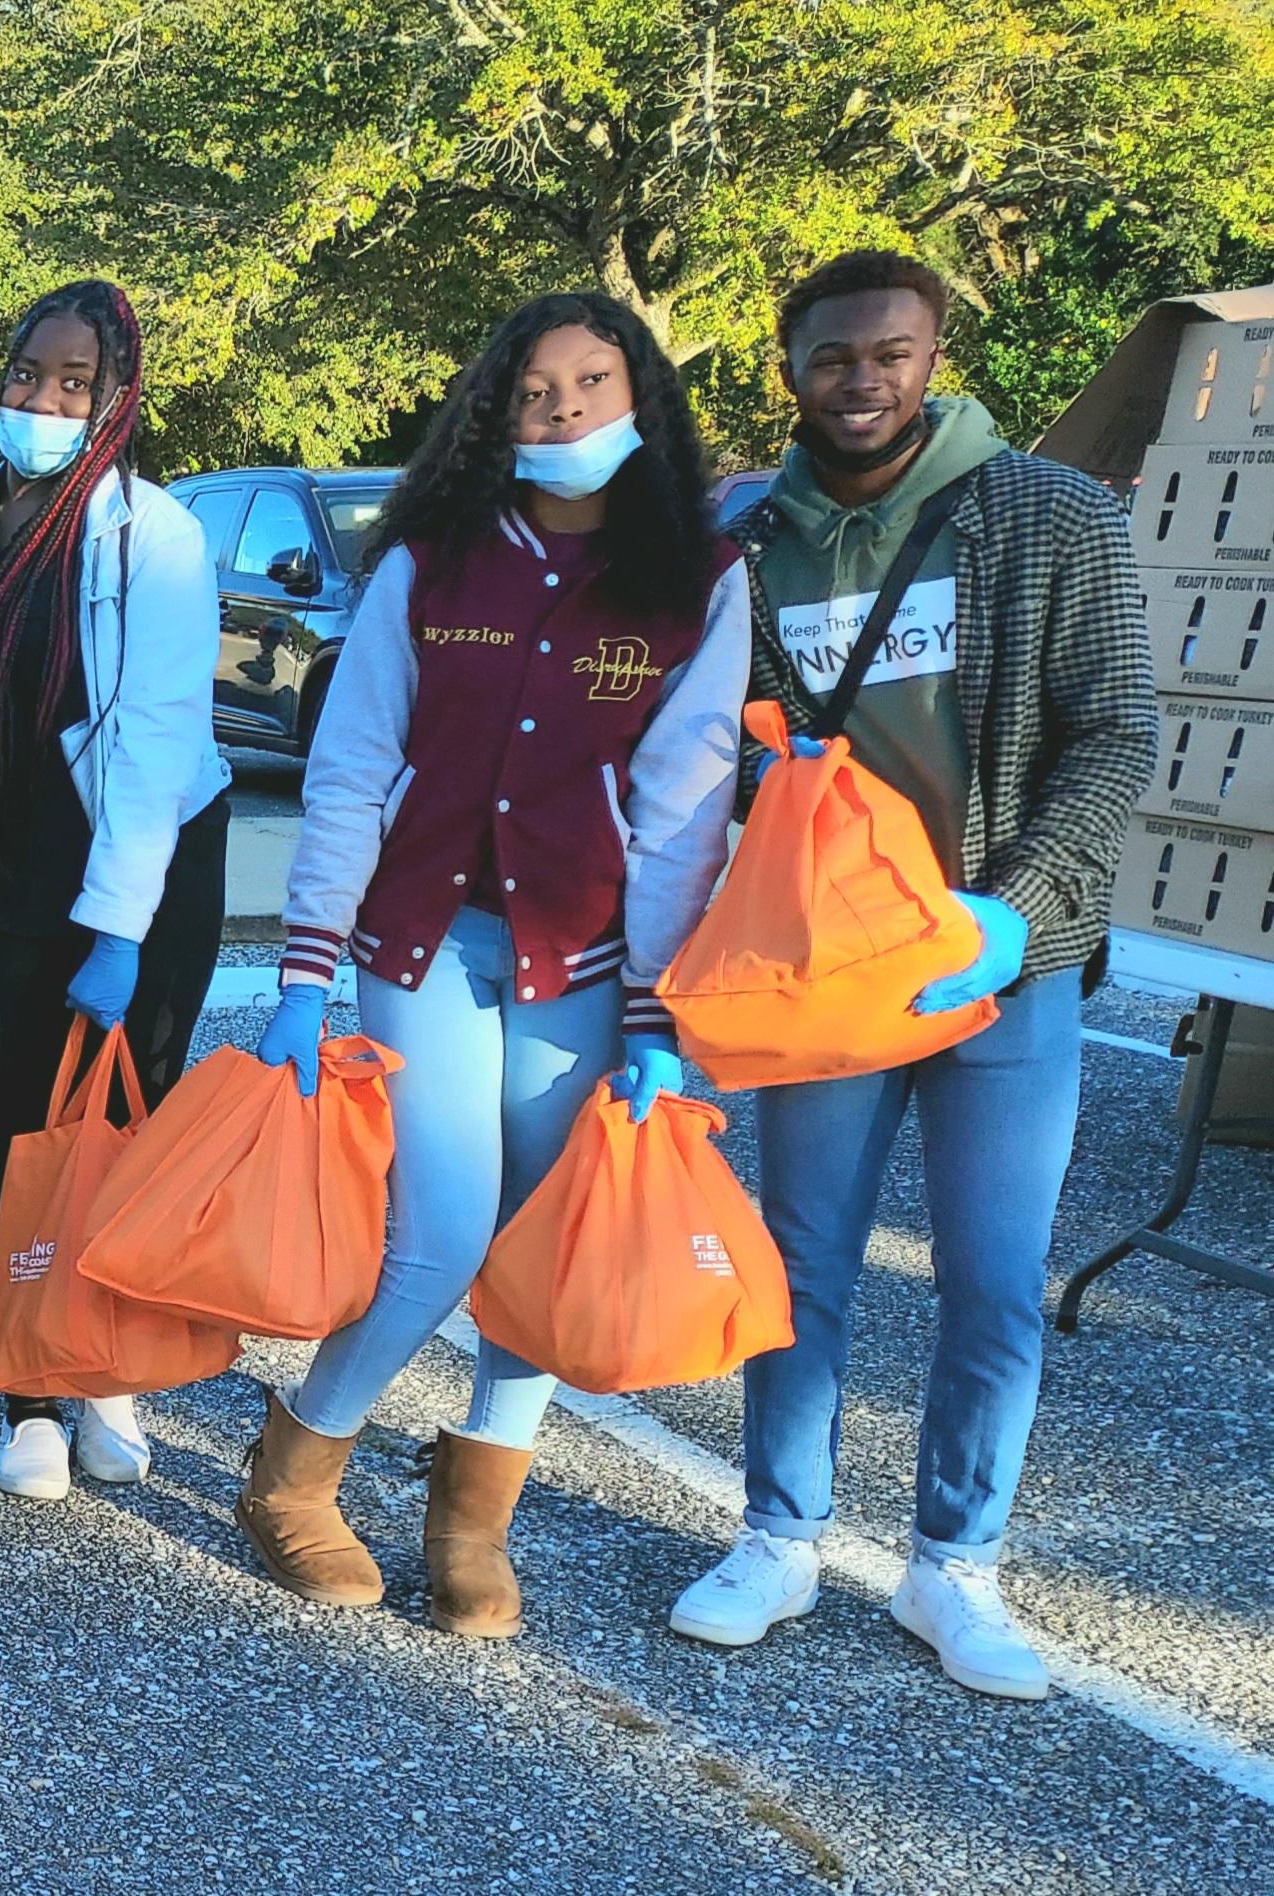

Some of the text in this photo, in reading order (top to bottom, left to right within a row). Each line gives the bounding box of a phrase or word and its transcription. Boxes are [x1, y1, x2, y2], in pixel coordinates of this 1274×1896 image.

[1207, 451, 1240, 464] READY
[1242, 451, 1255, 464] TO
[1215, 547, 1271, 562] PERISHABLE
[1174, 575, 1208, 589] READY
[1210, 576, 1224, 590] TO
[1225, 576, 1254, 591] COOK
[783, 623, 821, 638] Keep
[825, 613, 866, 632] That
[423, 626, 515, 646] Wyzzler
[787, 621, 956, 678] INNRGY
[1181, 671, 1239, 687] PERISHABLE
[1166, 703, 1274, 725] READY TO COOK TURKEY
[1170, 798, 1220, 816] PERISHABLE
[1146, 821, 1174, 836] READY
[1176, 825, 1188, 839] TO
